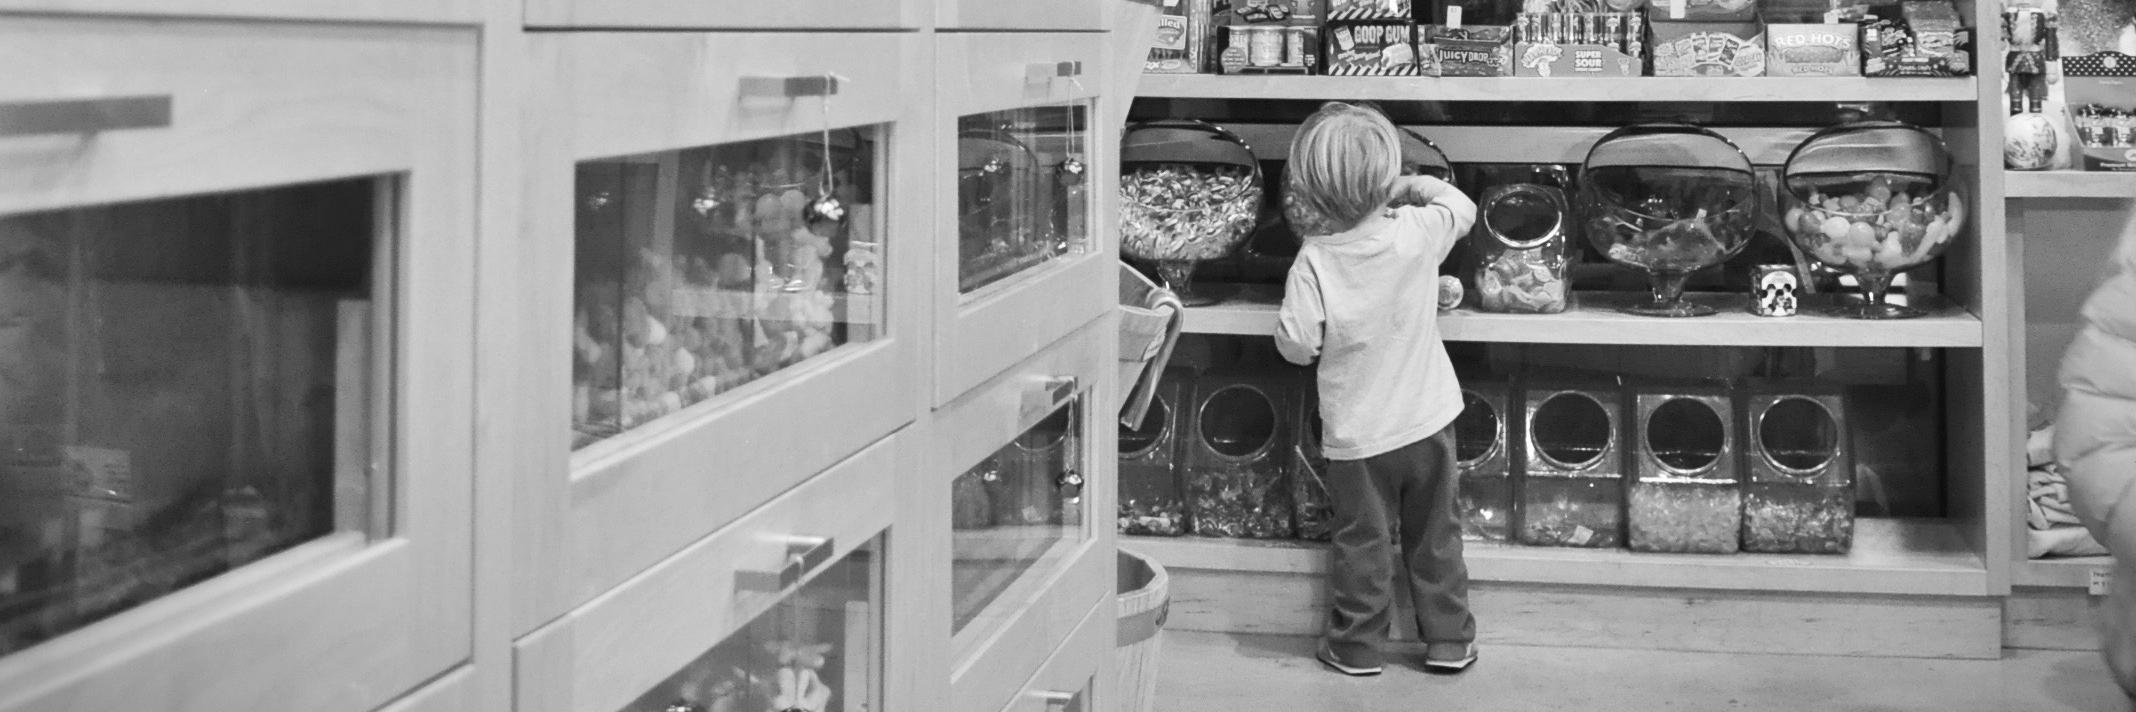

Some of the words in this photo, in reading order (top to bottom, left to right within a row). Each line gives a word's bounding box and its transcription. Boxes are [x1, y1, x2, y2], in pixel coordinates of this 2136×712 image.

[1354, 25, 1384, 44] GOOP
[1385, 25, 1411, 44] GUM
[1775, 33, 1806, 47] RED
[1811, 33, 1851, 49] HOTS
[1438, 49, 1468, 63] JUICY
[1468, 51, 1489, 62] DROP
[1575, 50, 1602, 59] SUPER
[1575, 58, 1602, 67] SOUR
